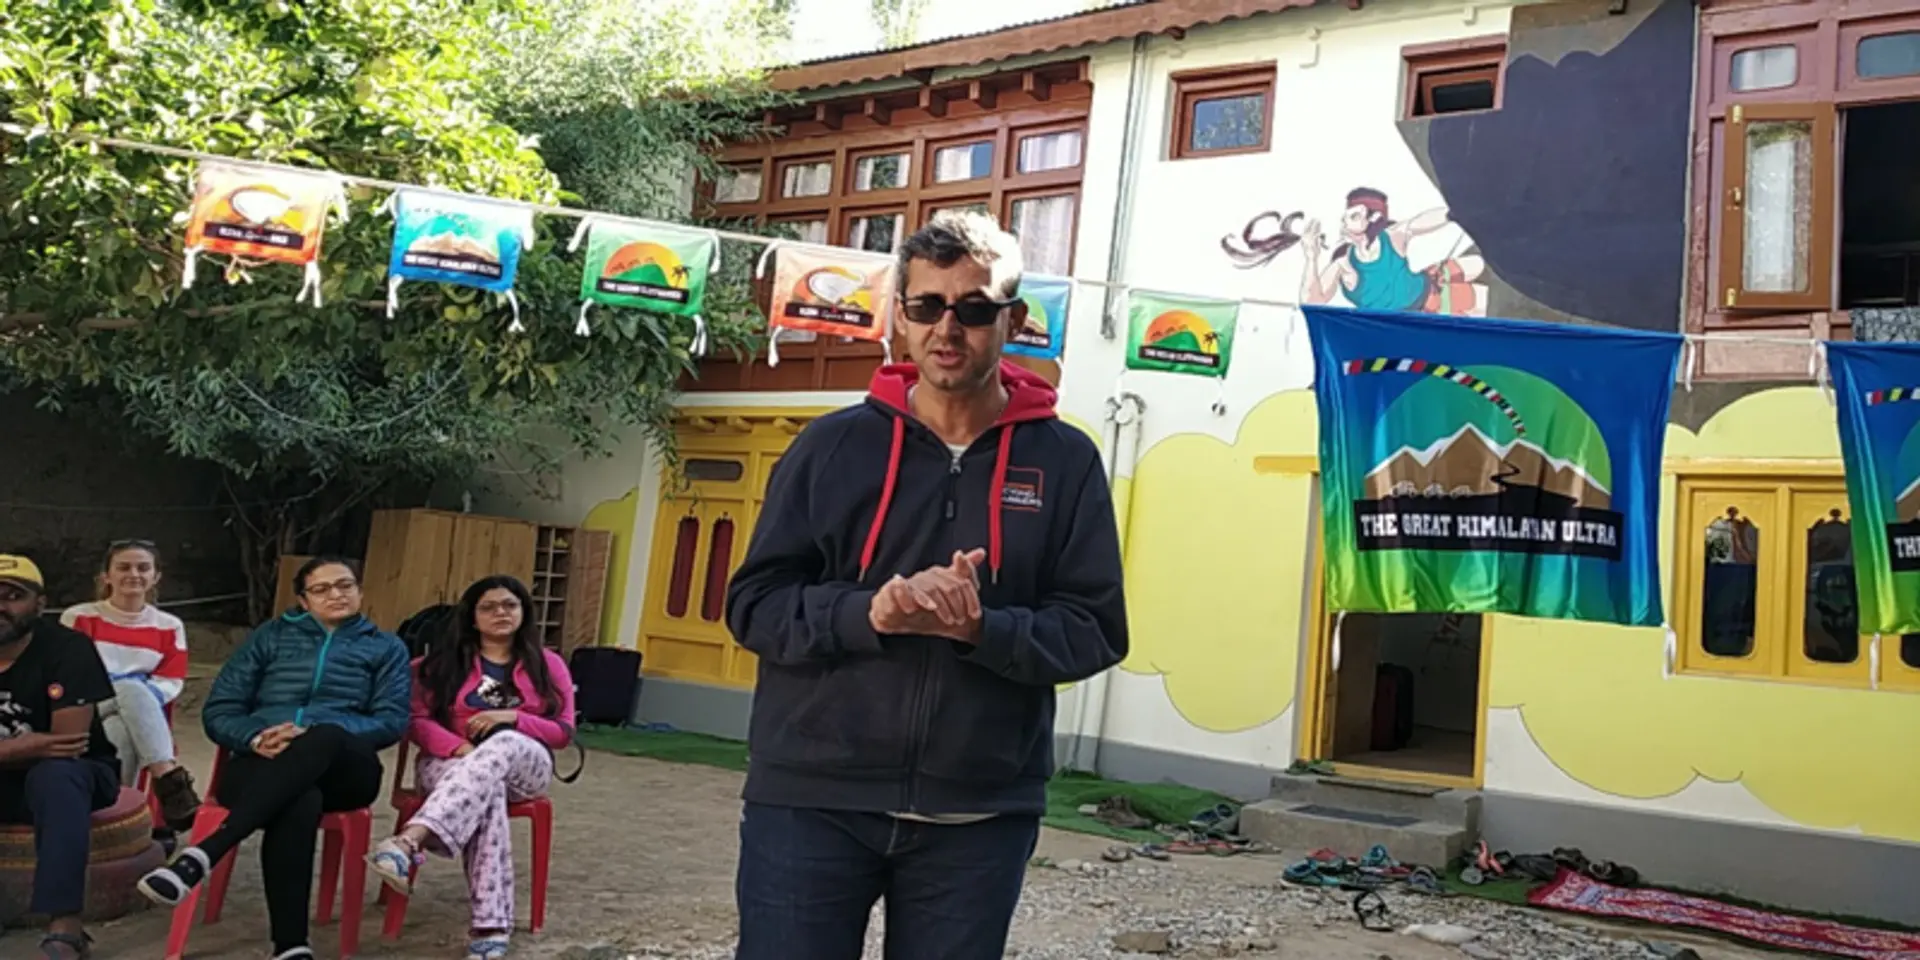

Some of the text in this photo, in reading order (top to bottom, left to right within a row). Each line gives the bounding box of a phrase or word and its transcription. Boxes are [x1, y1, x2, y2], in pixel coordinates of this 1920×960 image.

[1361, 513, 1398, 537] THE
[1402, 513, 1451, 537] GREAT
[1562, 520, 1617, 547] ULTRA
